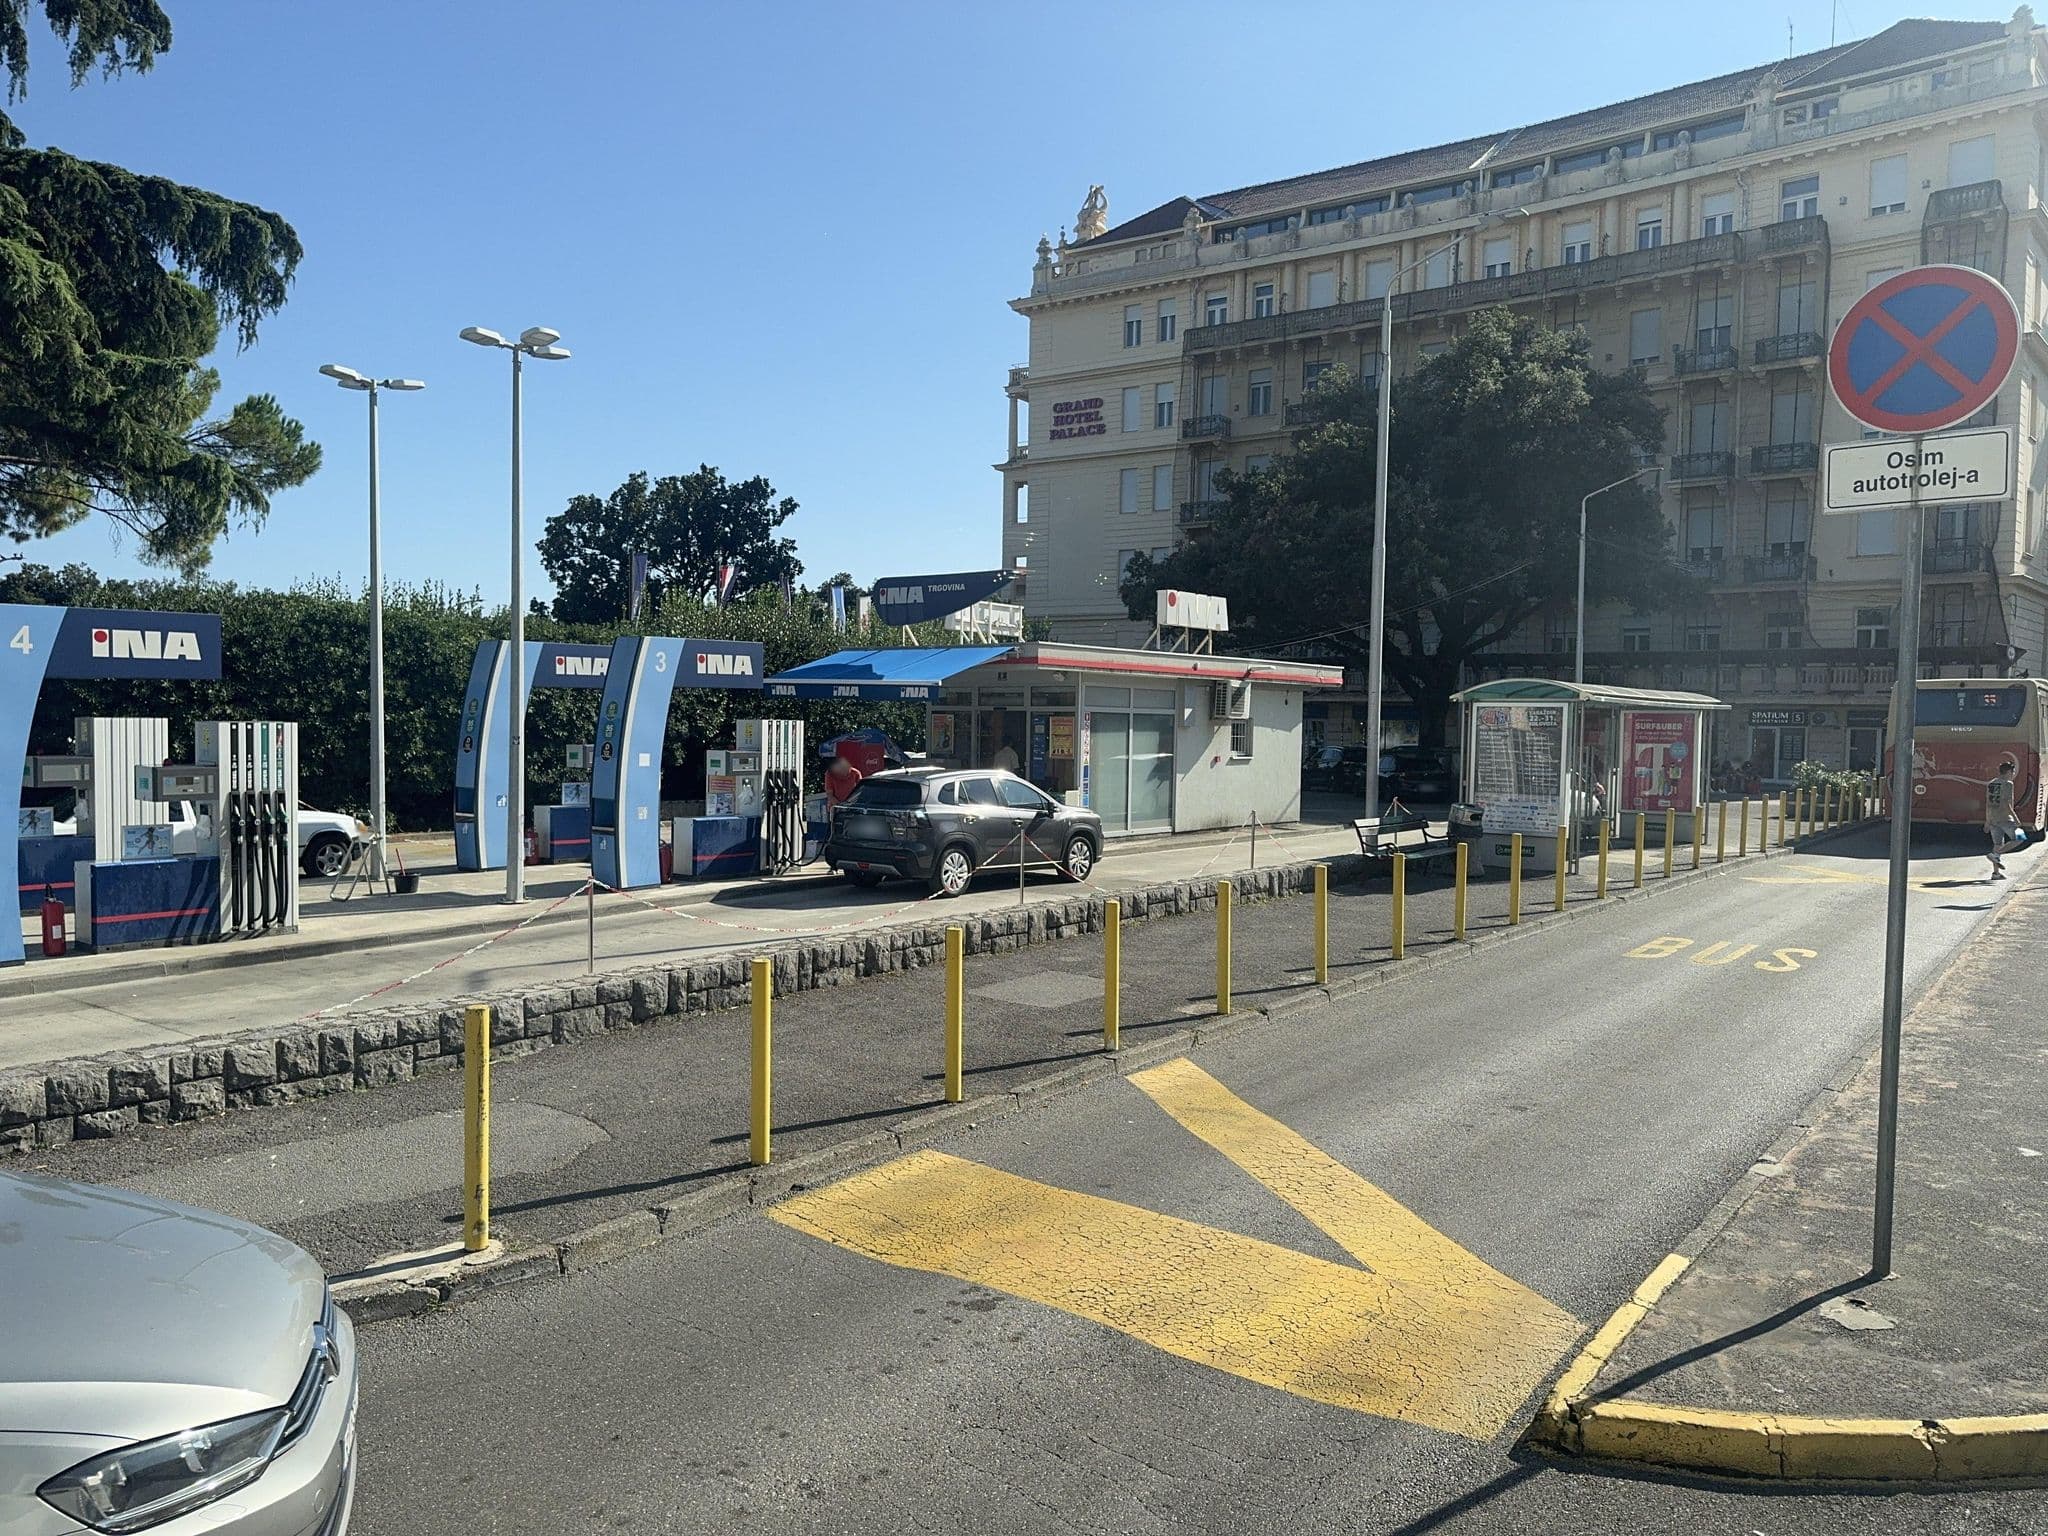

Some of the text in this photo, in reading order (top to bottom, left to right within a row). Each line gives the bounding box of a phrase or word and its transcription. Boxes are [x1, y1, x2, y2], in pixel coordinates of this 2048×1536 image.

[1052, 397, 1104, 414] GRAND
[1053, 411, 1103, 427] HOTEL
[1049, 424, 1106, 440] PALACE
[1886, 450, 1944, 469] Osim
[1853, 467, 1979, 494] autotrolej-a
[928, 583, 965, 593] TRGOVINA
[9, 625, 34, 655] 4
[655, 651, 667, 673] 3
[1621, 936, 1818, 972] BUS
